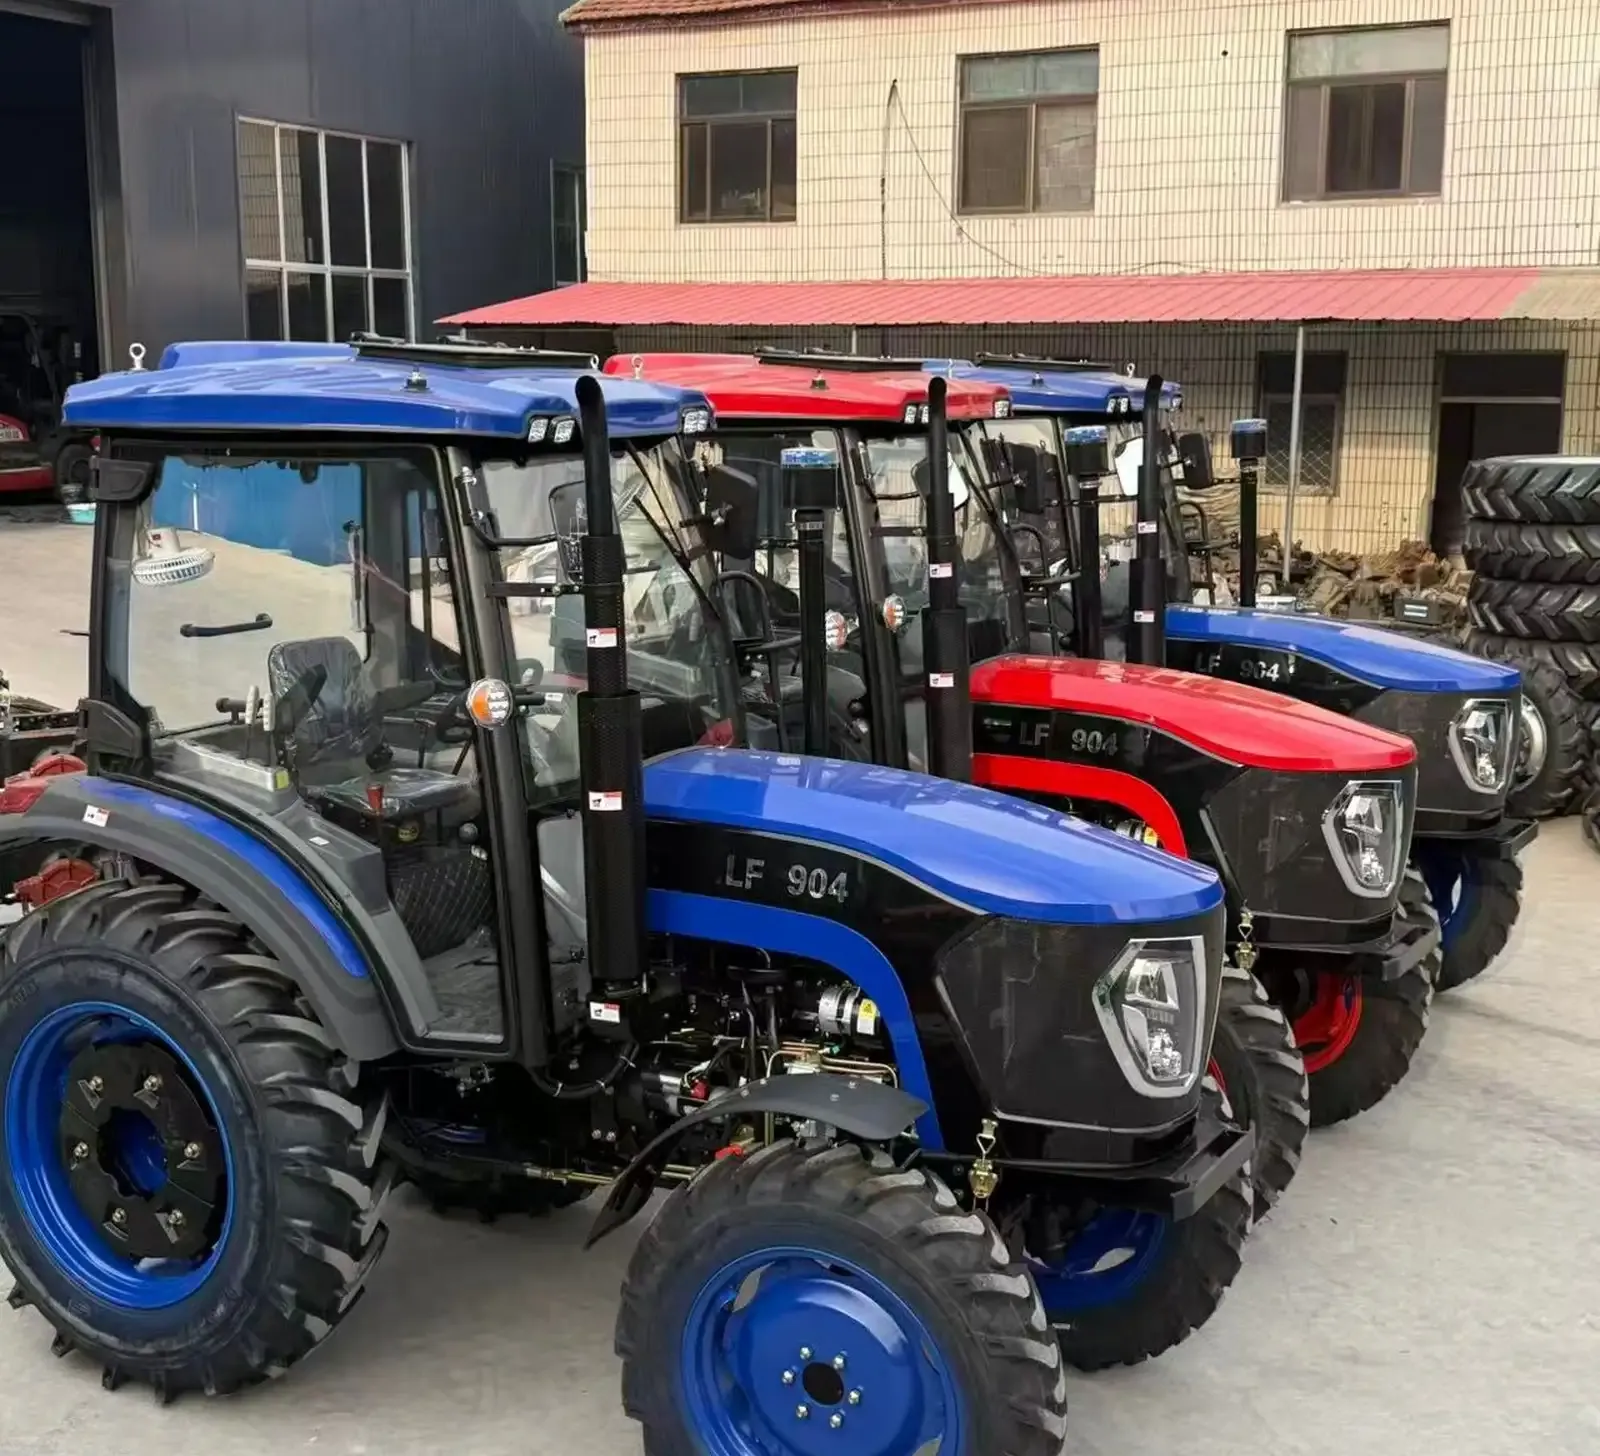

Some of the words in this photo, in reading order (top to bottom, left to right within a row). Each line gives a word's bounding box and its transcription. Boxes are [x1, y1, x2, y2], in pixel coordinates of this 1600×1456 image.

[1194, 652, 1221, 674] LF
[1019, 721, 1050, 746] LF
[1071, 728, 1118, 756] 904
[725, 854, 765, 890] LF
[786, 864, 849, 903] 904
